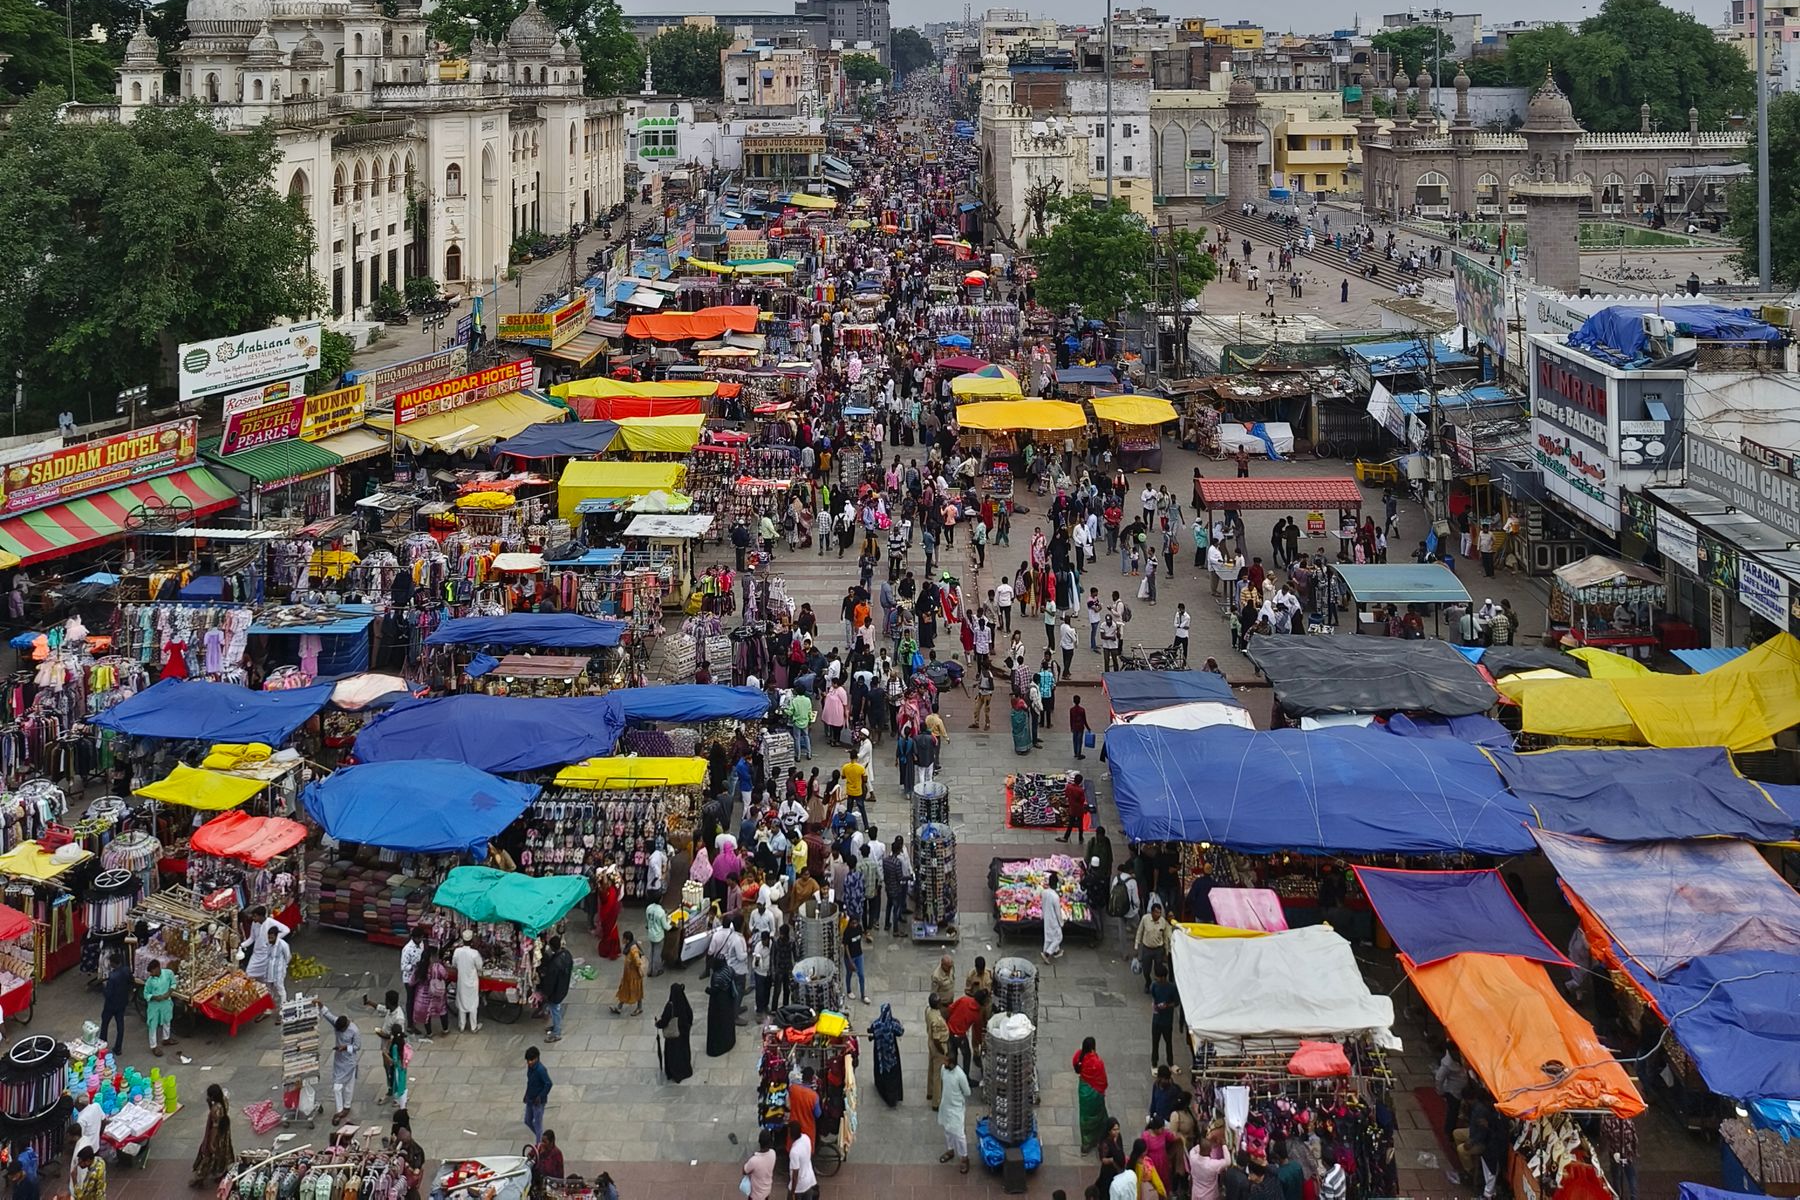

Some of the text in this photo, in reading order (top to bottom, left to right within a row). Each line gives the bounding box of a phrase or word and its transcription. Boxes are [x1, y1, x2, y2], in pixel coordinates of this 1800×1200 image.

[744, 138, 824, 147] KINGS JUICE CENTER
[695, 226, 720, 235] MILAN
[506, 314, 545, 326] SHAMS
[228, 337, 291, 360] Arabiana
[376, 362, 424, 386] MUQADDAR
[425, 354, 450, 372] HOTEL
[400, 376, 479, 409] MUQADDAR
[480, 364, 521, 386] HOTEL
[1541, 360, 1607, 417] NIMRAH
[227, 393, 263, 412] ROSHAN
[306, 387, 361, 416] MUNNU
[1537, 397, 1558, 419] CAFE
[236, 425, 289, 449] PEARLS
[240, 412, 292, 436] DELHI
[31, 447, 101, 486] SADDAM
[106, 433, 159, 465] HOTEL
[1690, 437, 1758, 493] FARASHA
[1759, 470, 1800, 514] CAFE
[1733, 487, 1800, 535] DUM CHICKEN
[1742, 559, 1781, 592] FARASHA
